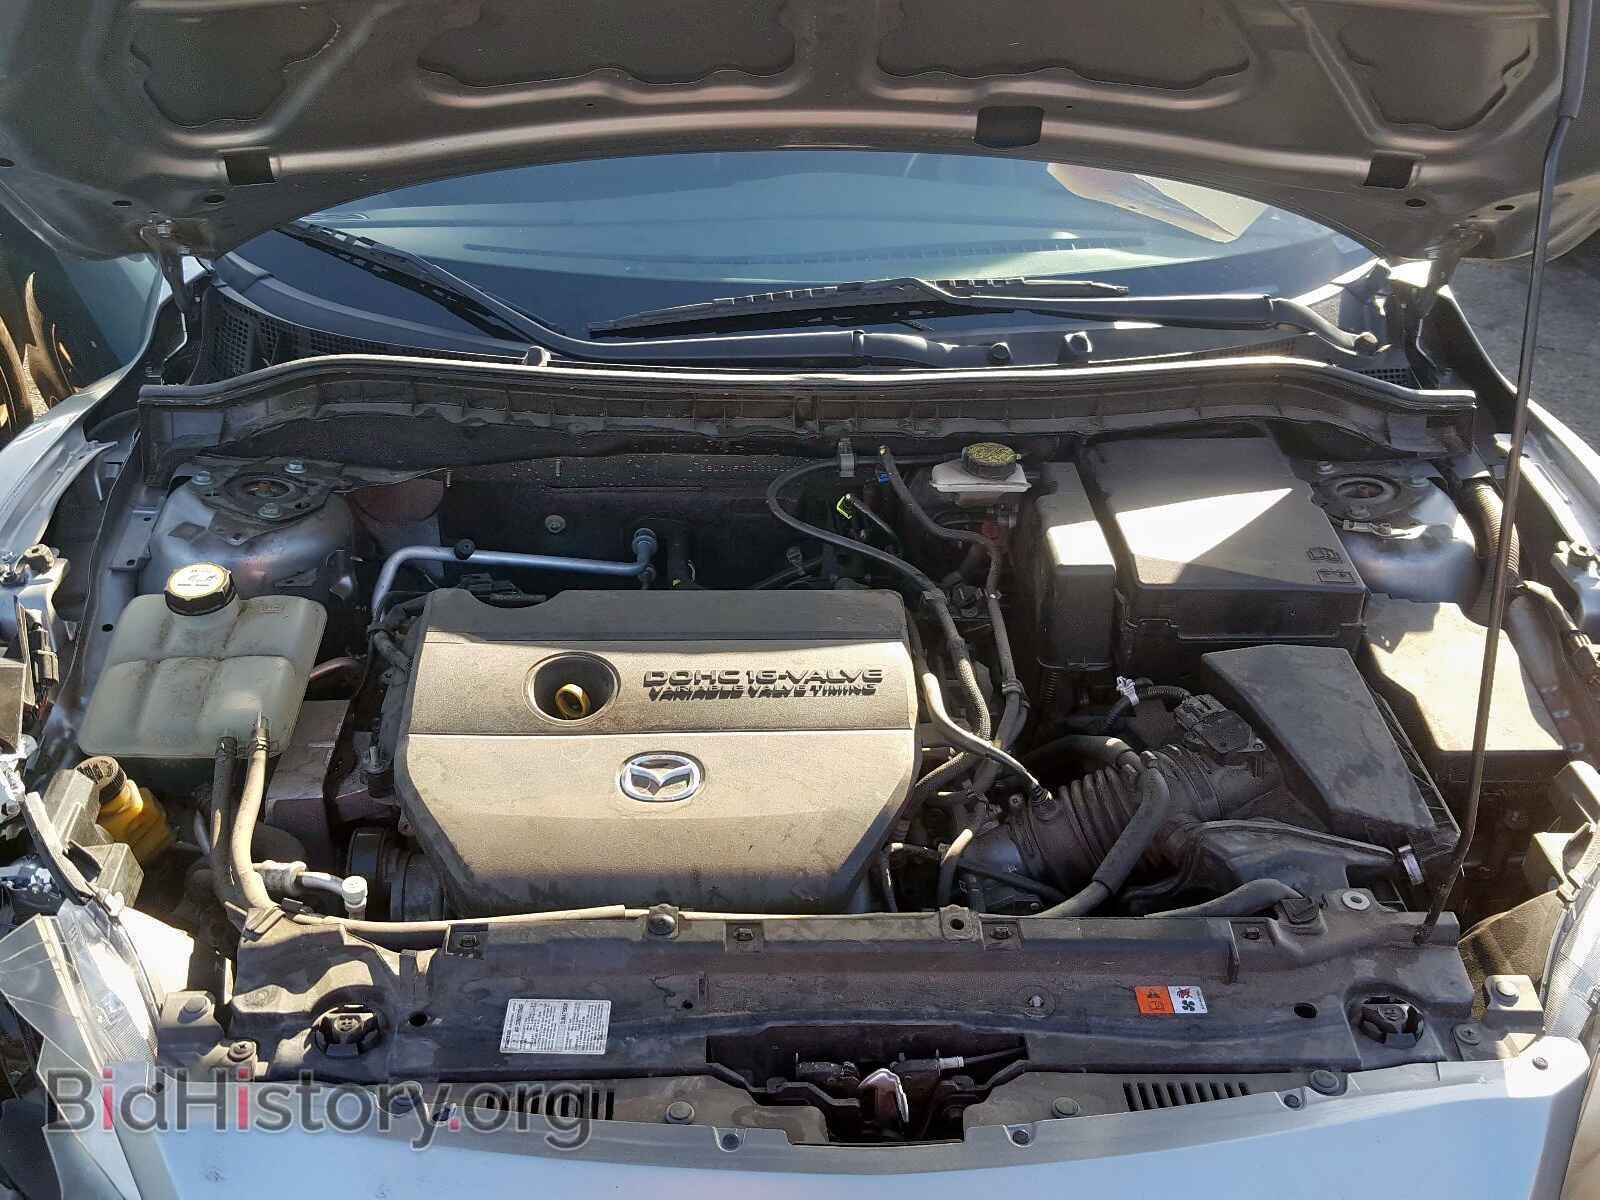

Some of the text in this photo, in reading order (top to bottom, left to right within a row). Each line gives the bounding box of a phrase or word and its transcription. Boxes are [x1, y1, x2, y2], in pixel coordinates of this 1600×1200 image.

[643, 669, 884, 686] DOHC 16-VALVE
[648, 683, 880, 701] VARIABLE VALVE TIMING
